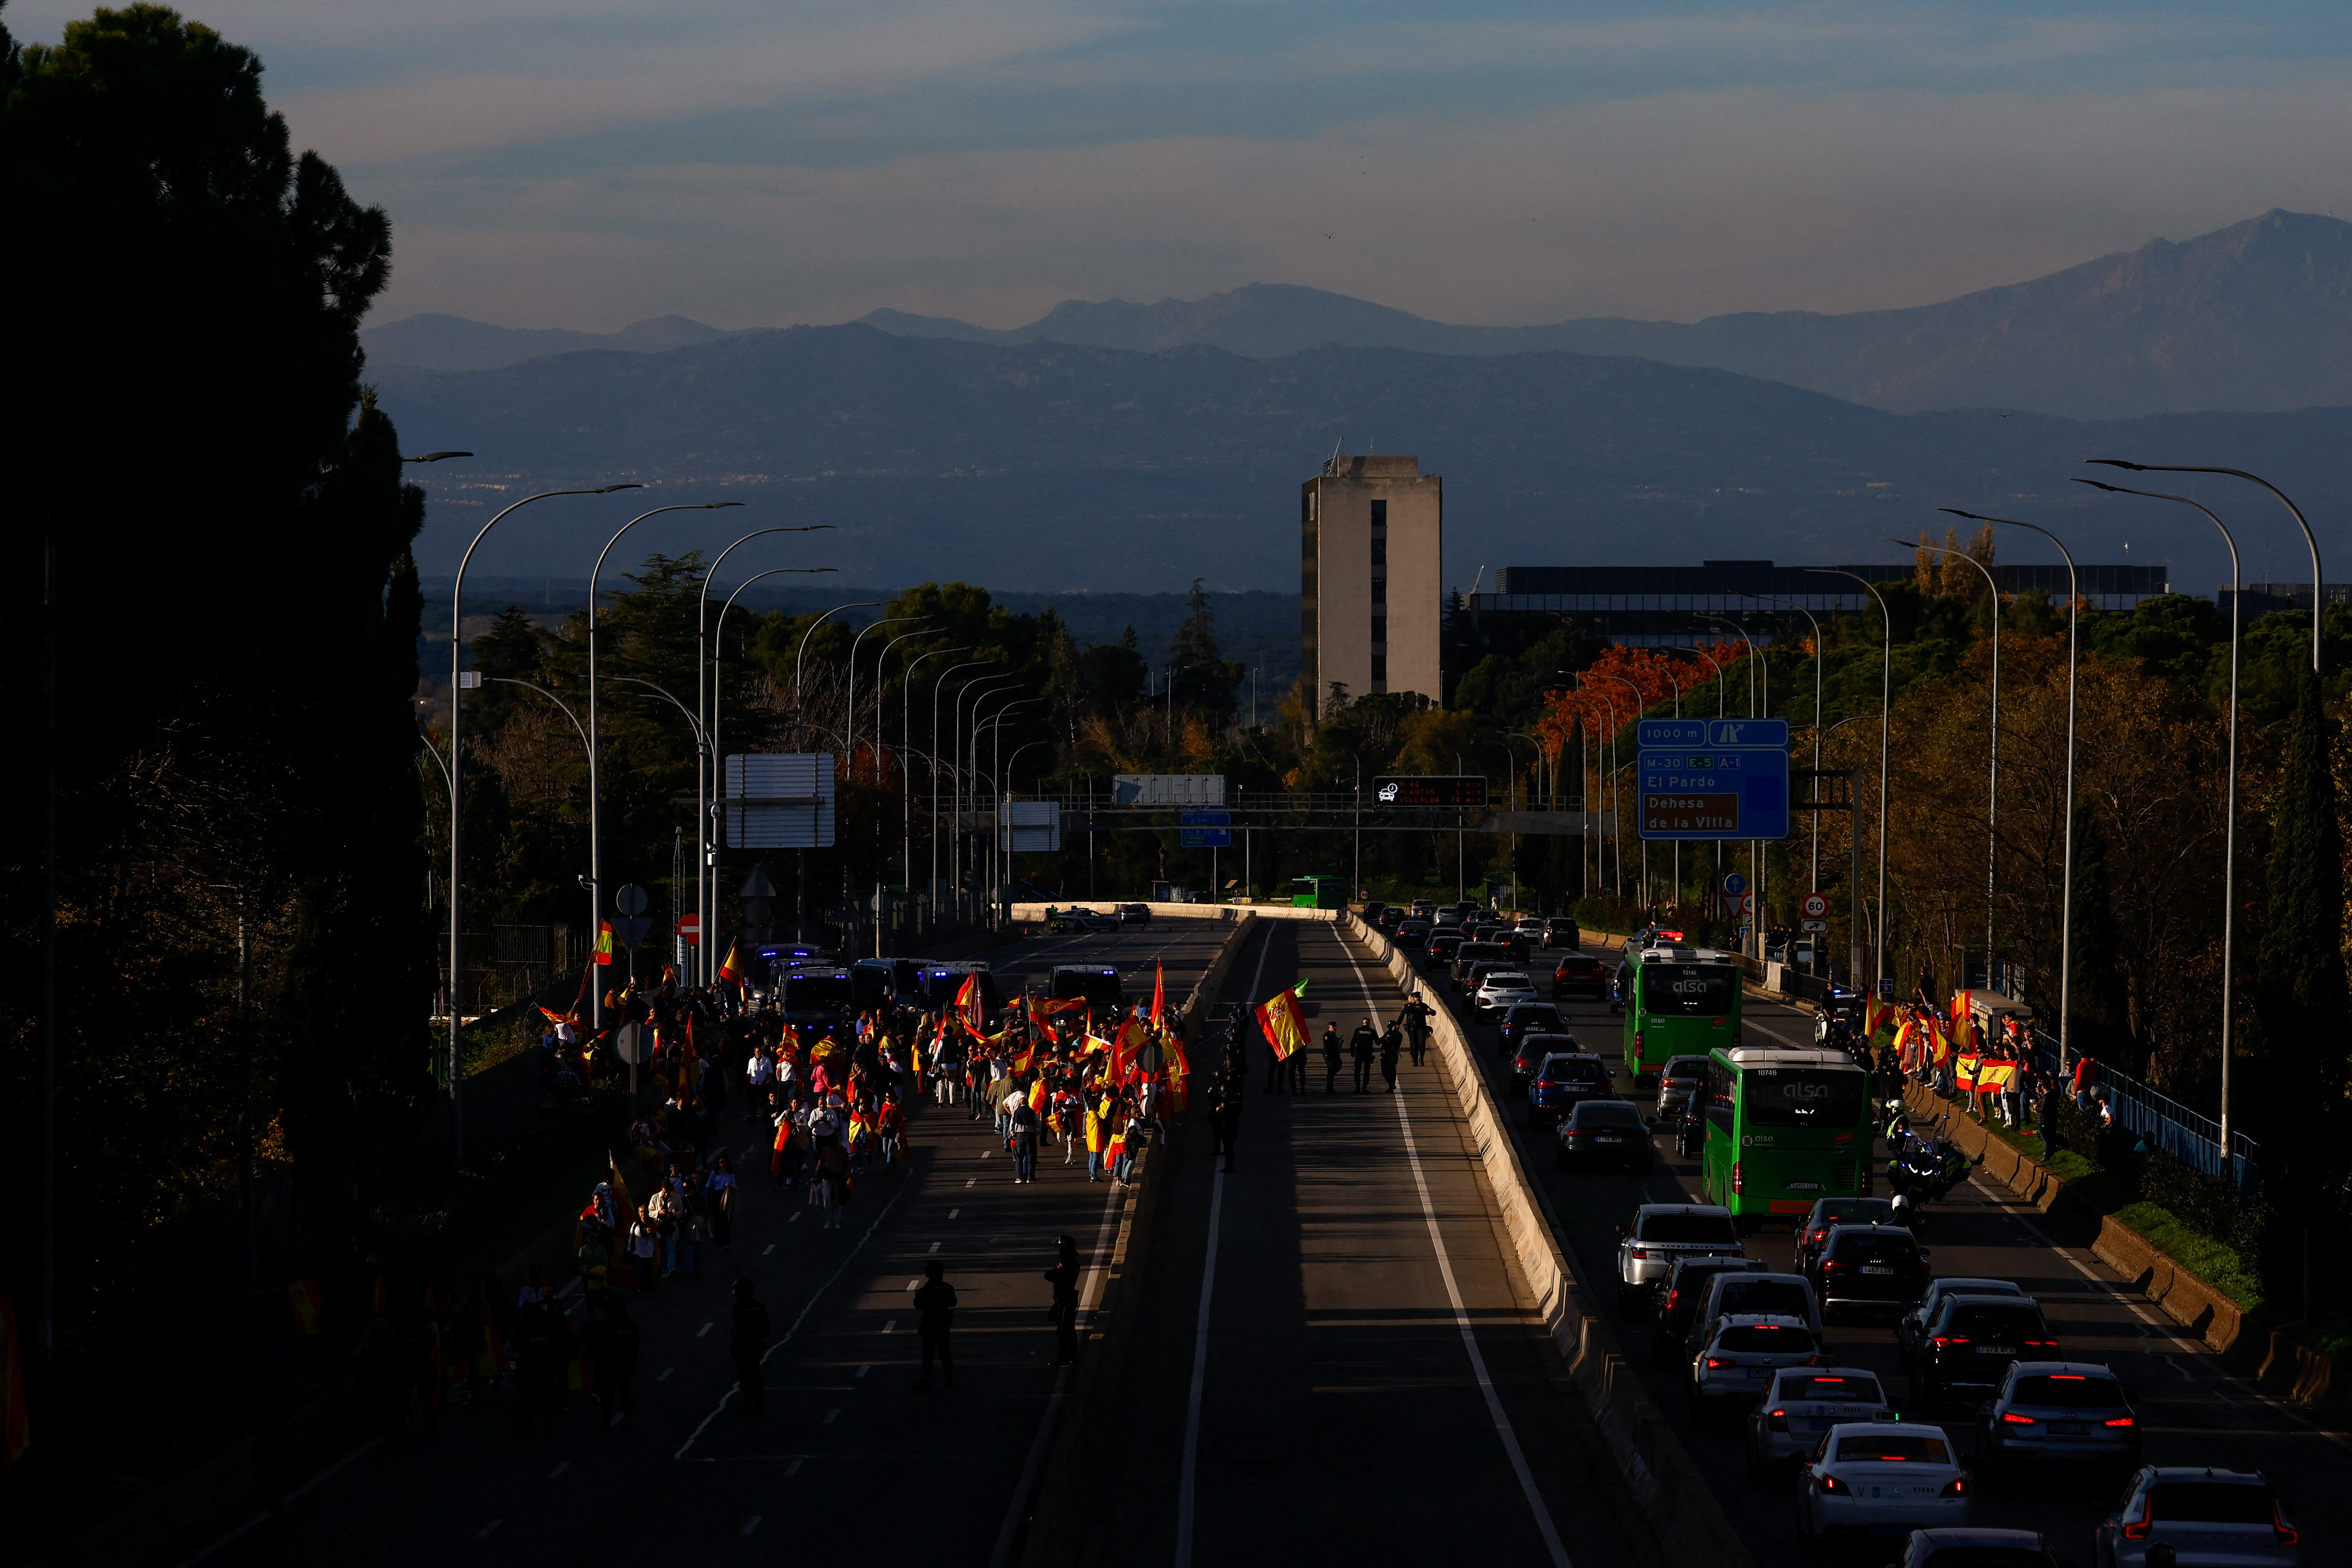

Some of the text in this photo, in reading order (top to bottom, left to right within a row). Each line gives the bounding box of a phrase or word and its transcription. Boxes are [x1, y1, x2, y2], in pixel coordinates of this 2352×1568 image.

[1647, 729, 1681, 738] 1000
[1647, 758, 1739, 768] M-30 E-5 A-1
[1648, 776, 1715, 787] El Pardo
[1649, 797, 1704, 808] Dehesa
[1649, 817, 1732, 828] de la Villa
[1808, 902, 1823, 911] 60
[1672, 980, 1707, 992] alsa
[1783, 1081, 1828, 1098] alsa
[1804, 1406, 1811, 1415] J
[1858, 1486, 1865, 1497] V
